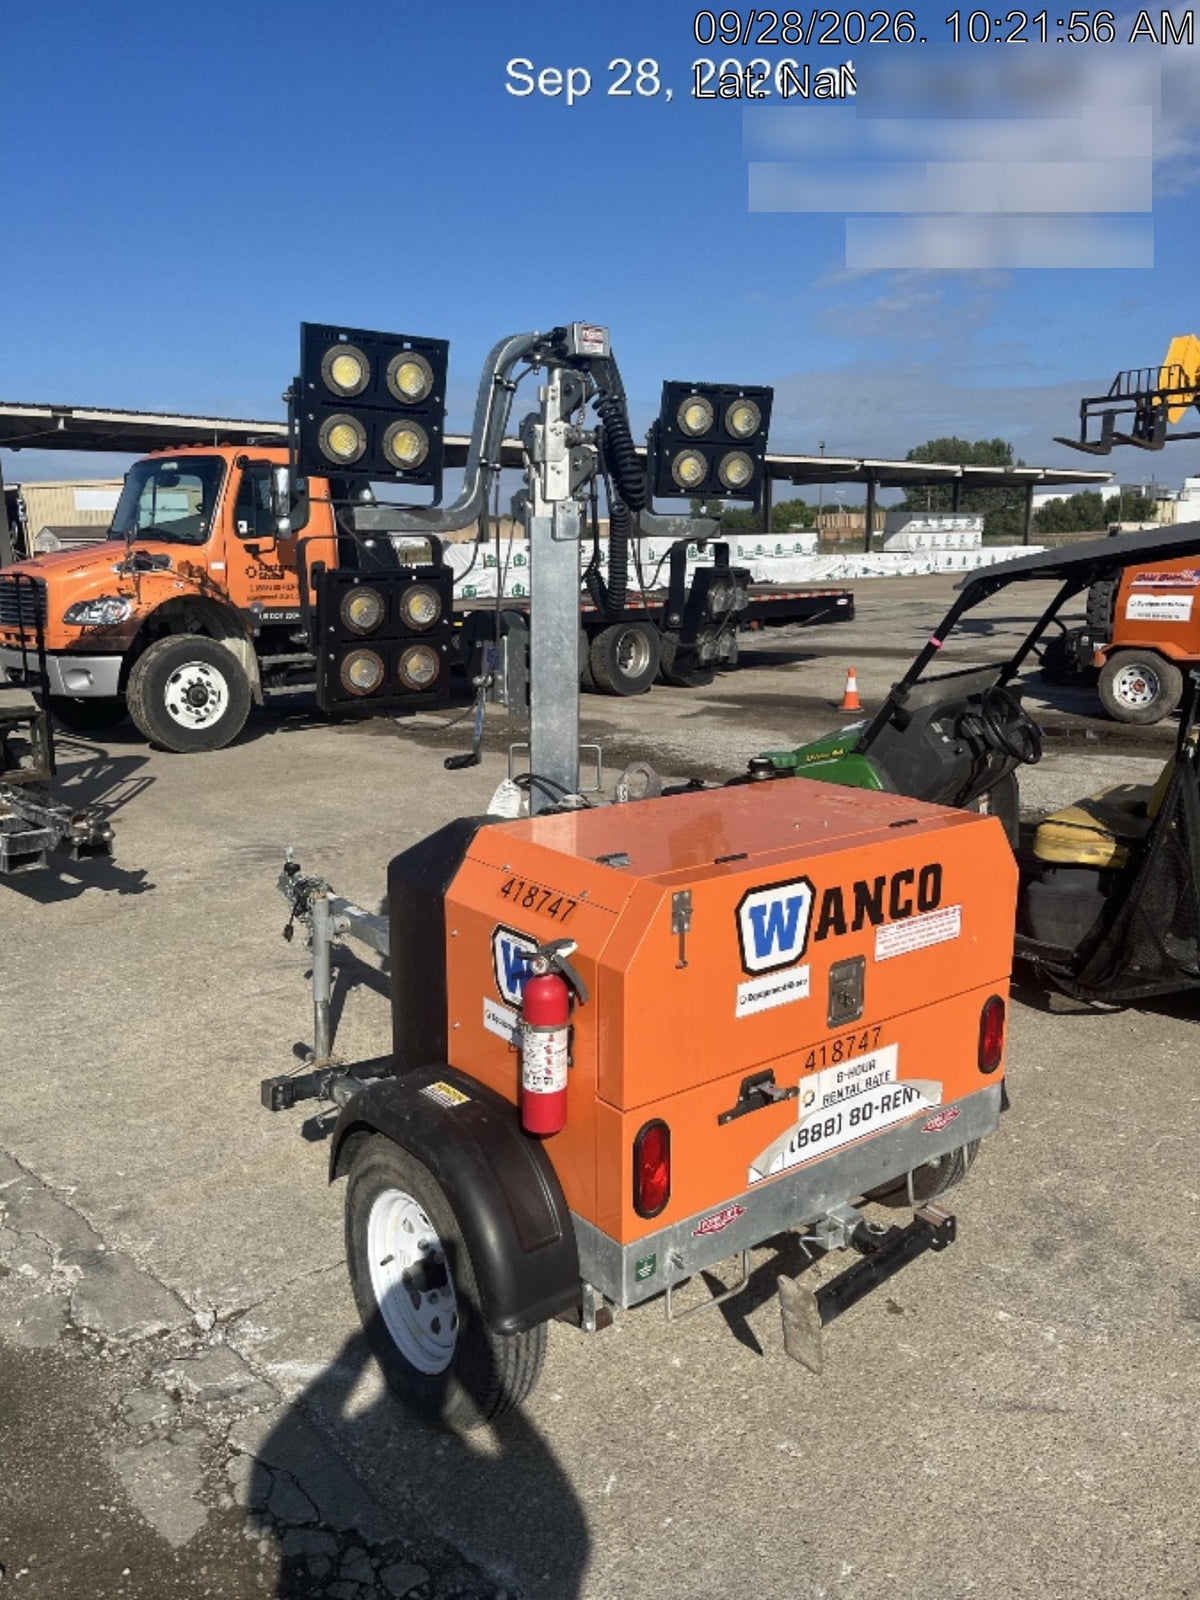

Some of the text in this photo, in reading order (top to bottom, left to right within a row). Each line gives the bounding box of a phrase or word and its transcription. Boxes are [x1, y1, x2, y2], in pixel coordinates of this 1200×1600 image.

[500, 877, 577, 922] 418747
[748, 862, 943, 960] WANCO
[804, 1026, 882, 1071] 418747
[822, 1069, 892, 1107] RENTAL RATE
